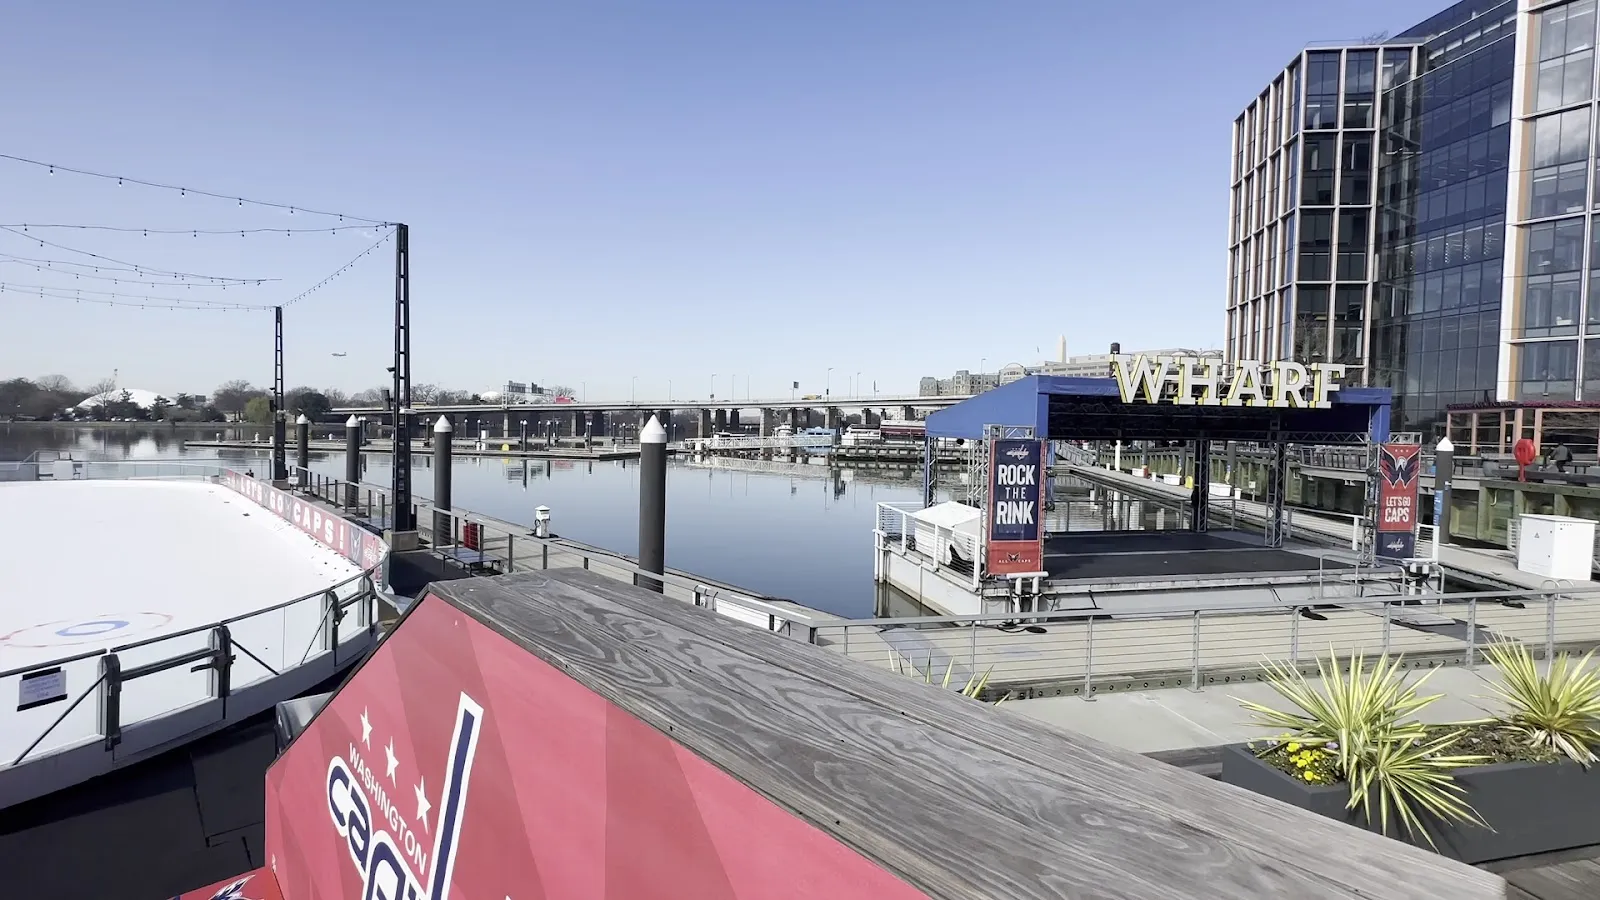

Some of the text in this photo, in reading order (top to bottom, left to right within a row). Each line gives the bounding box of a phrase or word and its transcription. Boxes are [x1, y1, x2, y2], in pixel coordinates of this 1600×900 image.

[1110, 354, 1346, 408] WHARF
[998, 464, 1035, 485] ROCK
[1005, 487, 1026, 499] THE
[1403, 496, 1411, 507] GO
[270, 491, 284, 511] GO
[293, 502, 344, 549] CAPS!
[996, 501, 1034, 525] RINK
[1385, 507, 1409, 522] CAPS
[350, 742, 427, 876] WASHINGTON
